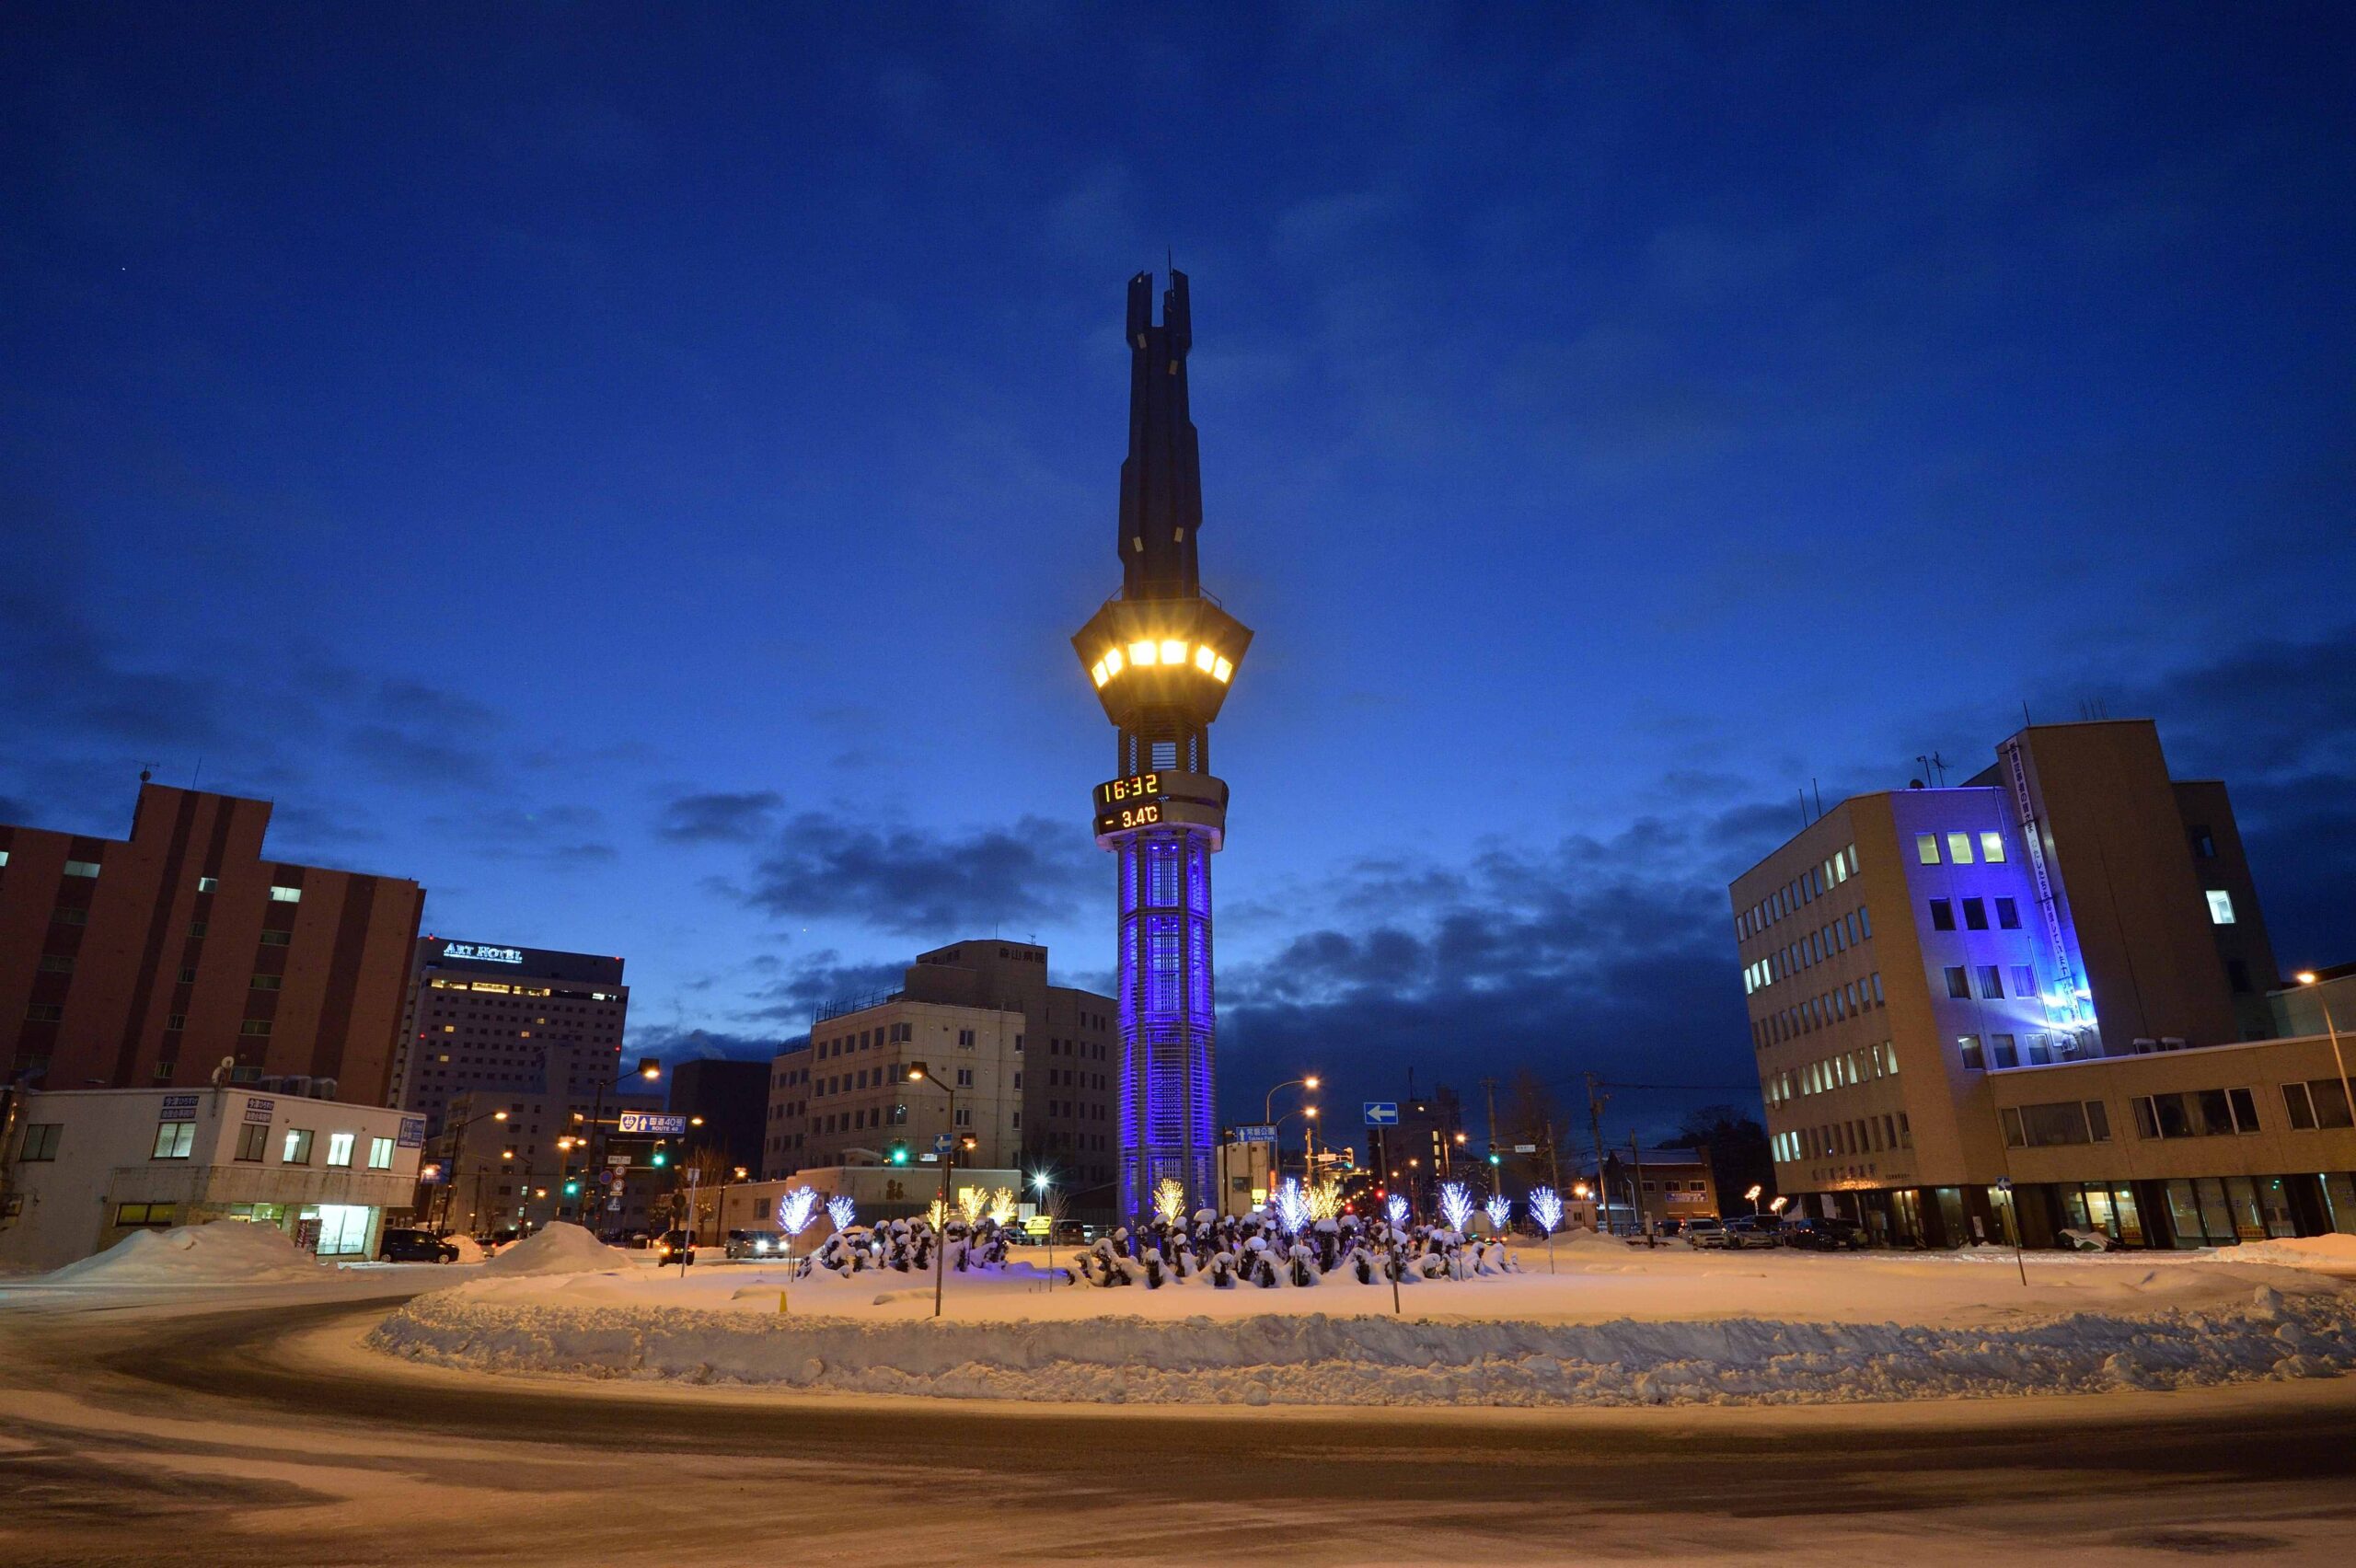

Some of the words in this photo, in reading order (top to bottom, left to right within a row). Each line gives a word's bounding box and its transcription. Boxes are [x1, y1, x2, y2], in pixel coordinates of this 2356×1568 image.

[1105, 774, 1158, 802] 16:32
[444, 942, 474, 956] ART
[476, 946, 523, 961] HOTEL
[649, 1117, 683, 1127] 国道40号
